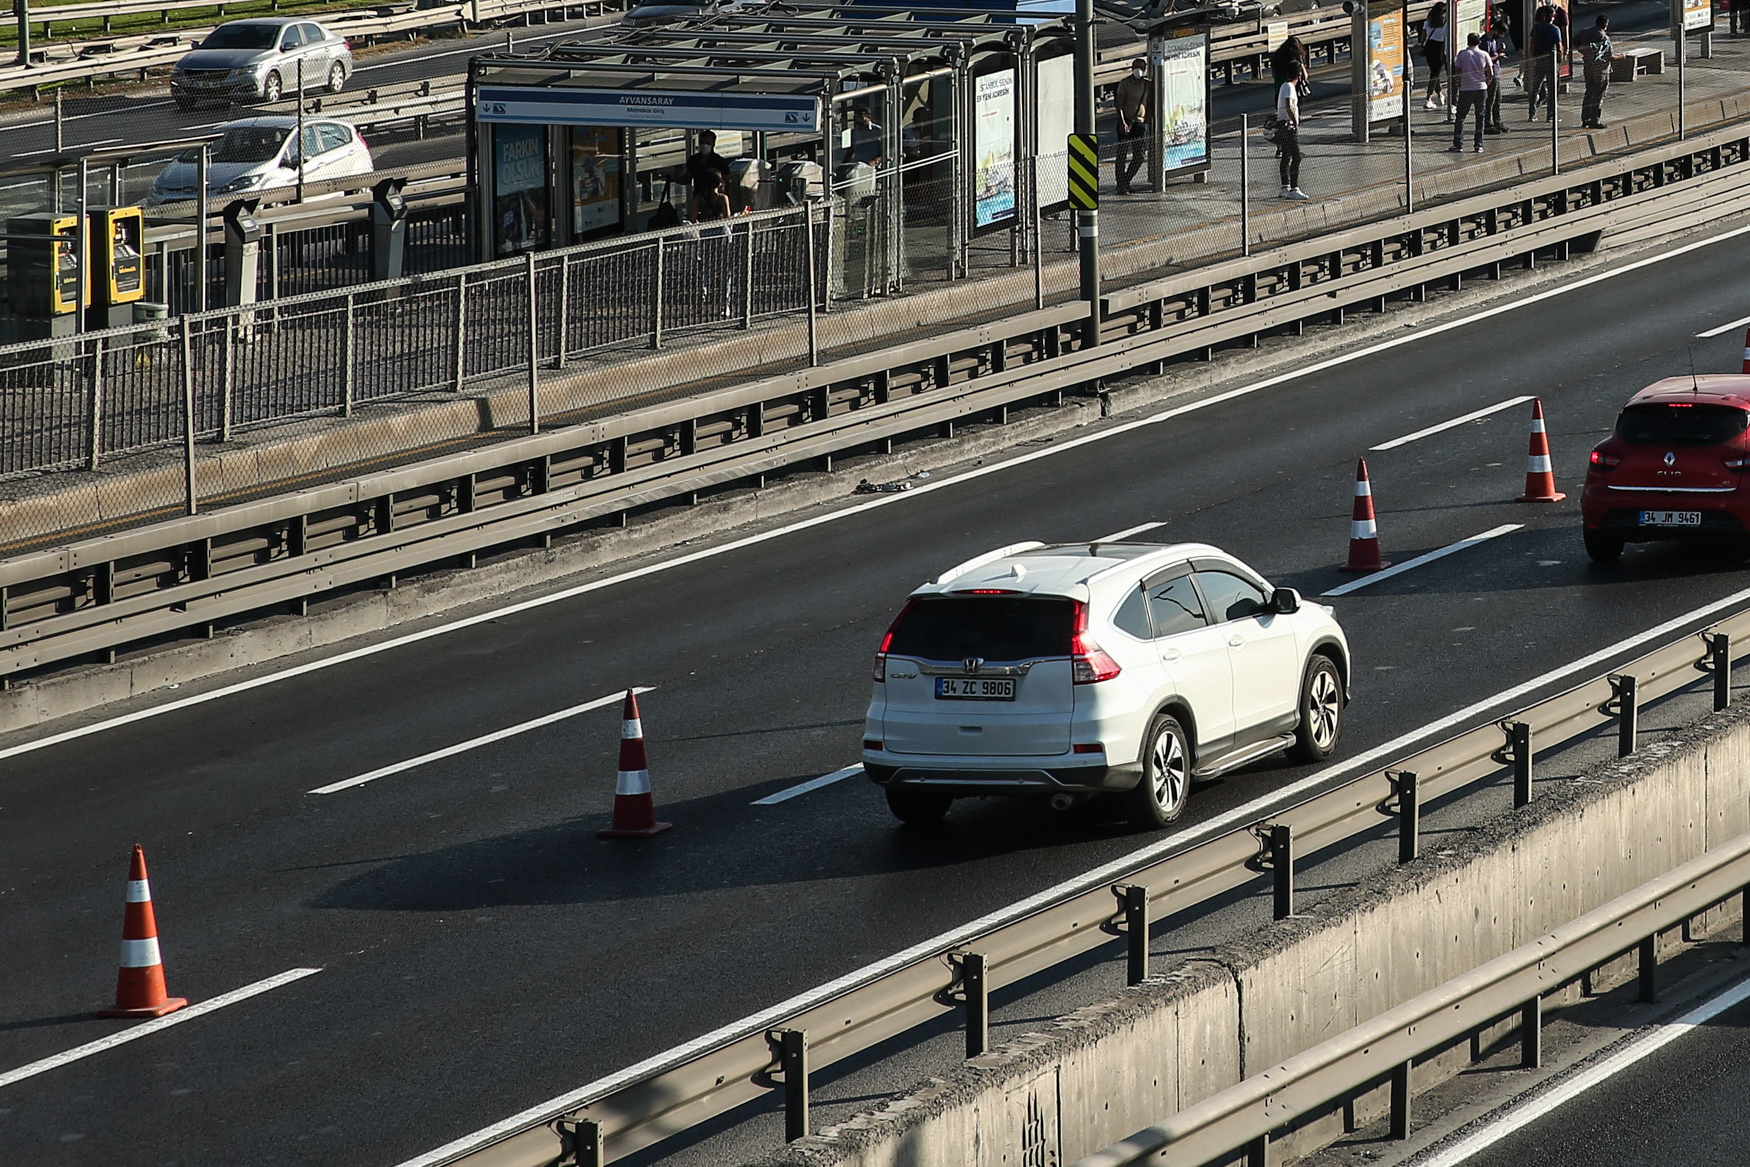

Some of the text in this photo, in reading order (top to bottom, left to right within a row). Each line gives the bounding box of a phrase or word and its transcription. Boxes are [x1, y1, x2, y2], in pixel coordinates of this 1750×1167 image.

[619, 96, 674, 106] AYVANSARAY
[502, 136, 538, 165] FARKIN
[502, 160, 540, 186] OLSUN
[1645, 512, 1699, 524] 34 JM 9461
[943, 680, 1011, 696] 34 ZC 9806
